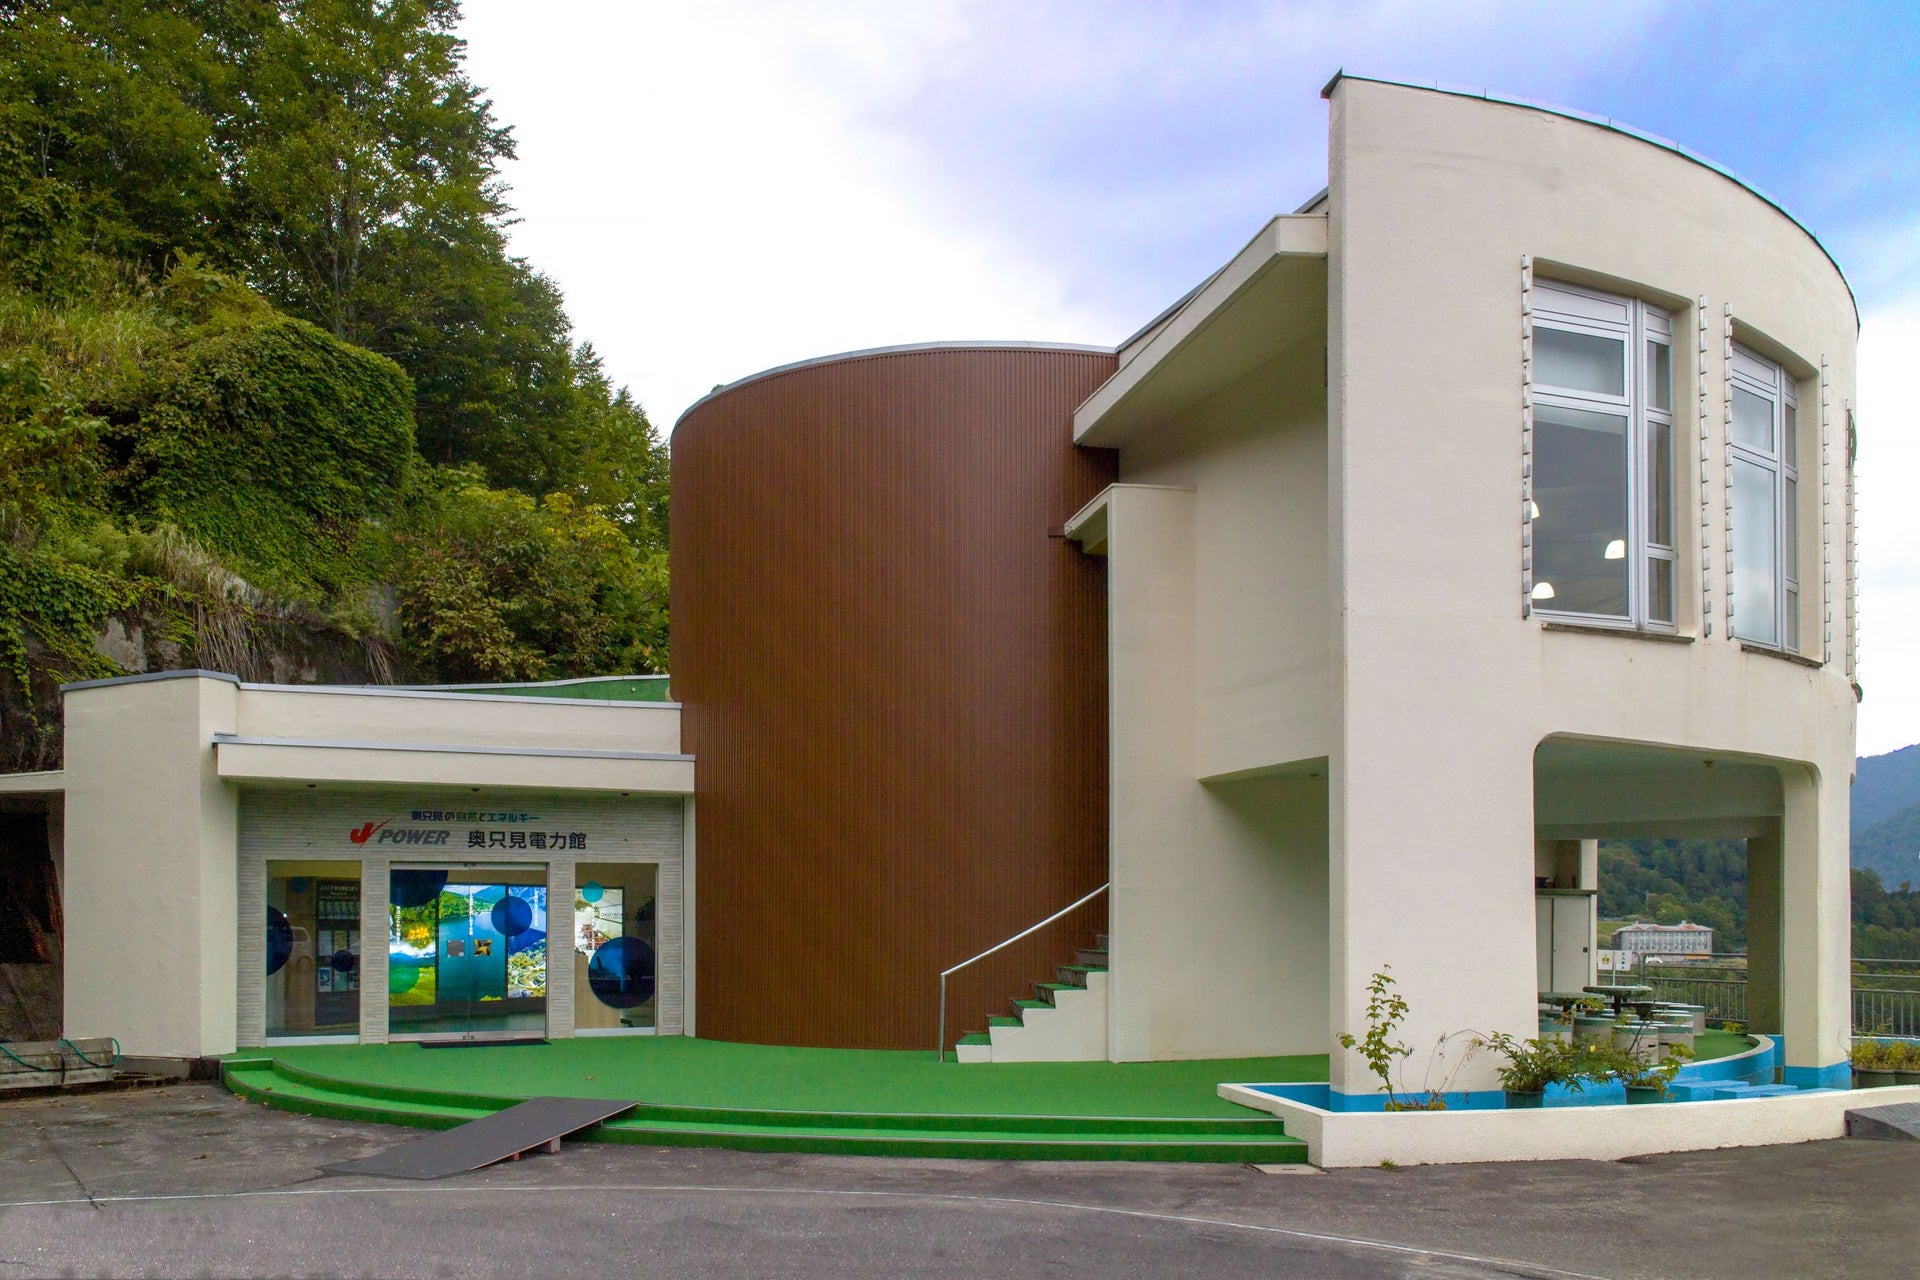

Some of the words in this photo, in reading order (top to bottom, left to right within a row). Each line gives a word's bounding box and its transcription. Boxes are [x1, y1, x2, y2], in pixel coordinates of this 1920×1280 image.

[377, 829, 451, 846] POWER
[467, 830, 587, 850] 奥只見電力館
